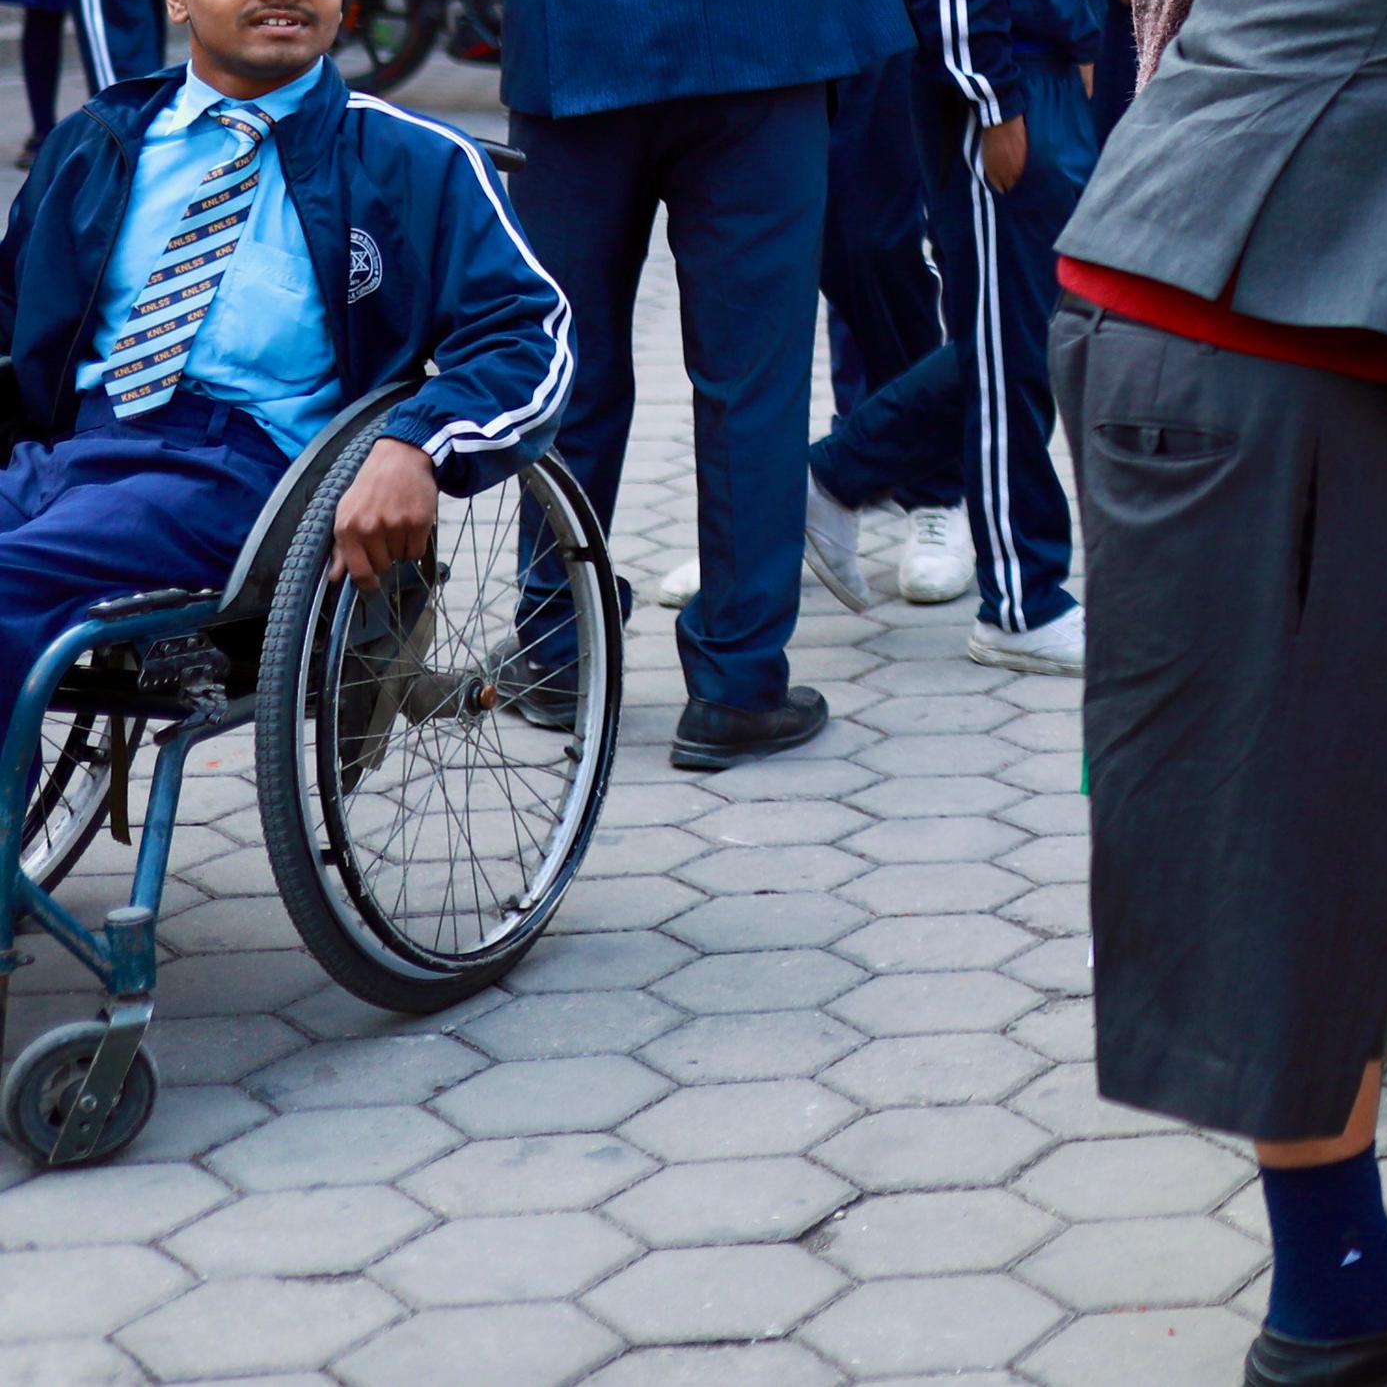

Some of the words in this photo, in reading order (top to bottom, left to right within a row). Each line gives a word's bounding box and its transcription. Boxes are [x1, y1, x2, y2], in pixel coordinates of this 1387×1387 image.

[208, 215, 237, 234] KNLSS
[174, 257, 205, 275] KNLSS
[141, 297, 170, 315] KNLSS
[182, 280, 211, 299] KNLSS
[146, 321, 176, 339] KNLSS
[114, 362, 144, 379] KNLSS
[153, 344, 183, 363] KNLSS
[121, 385, 151, 402] KNLSS
